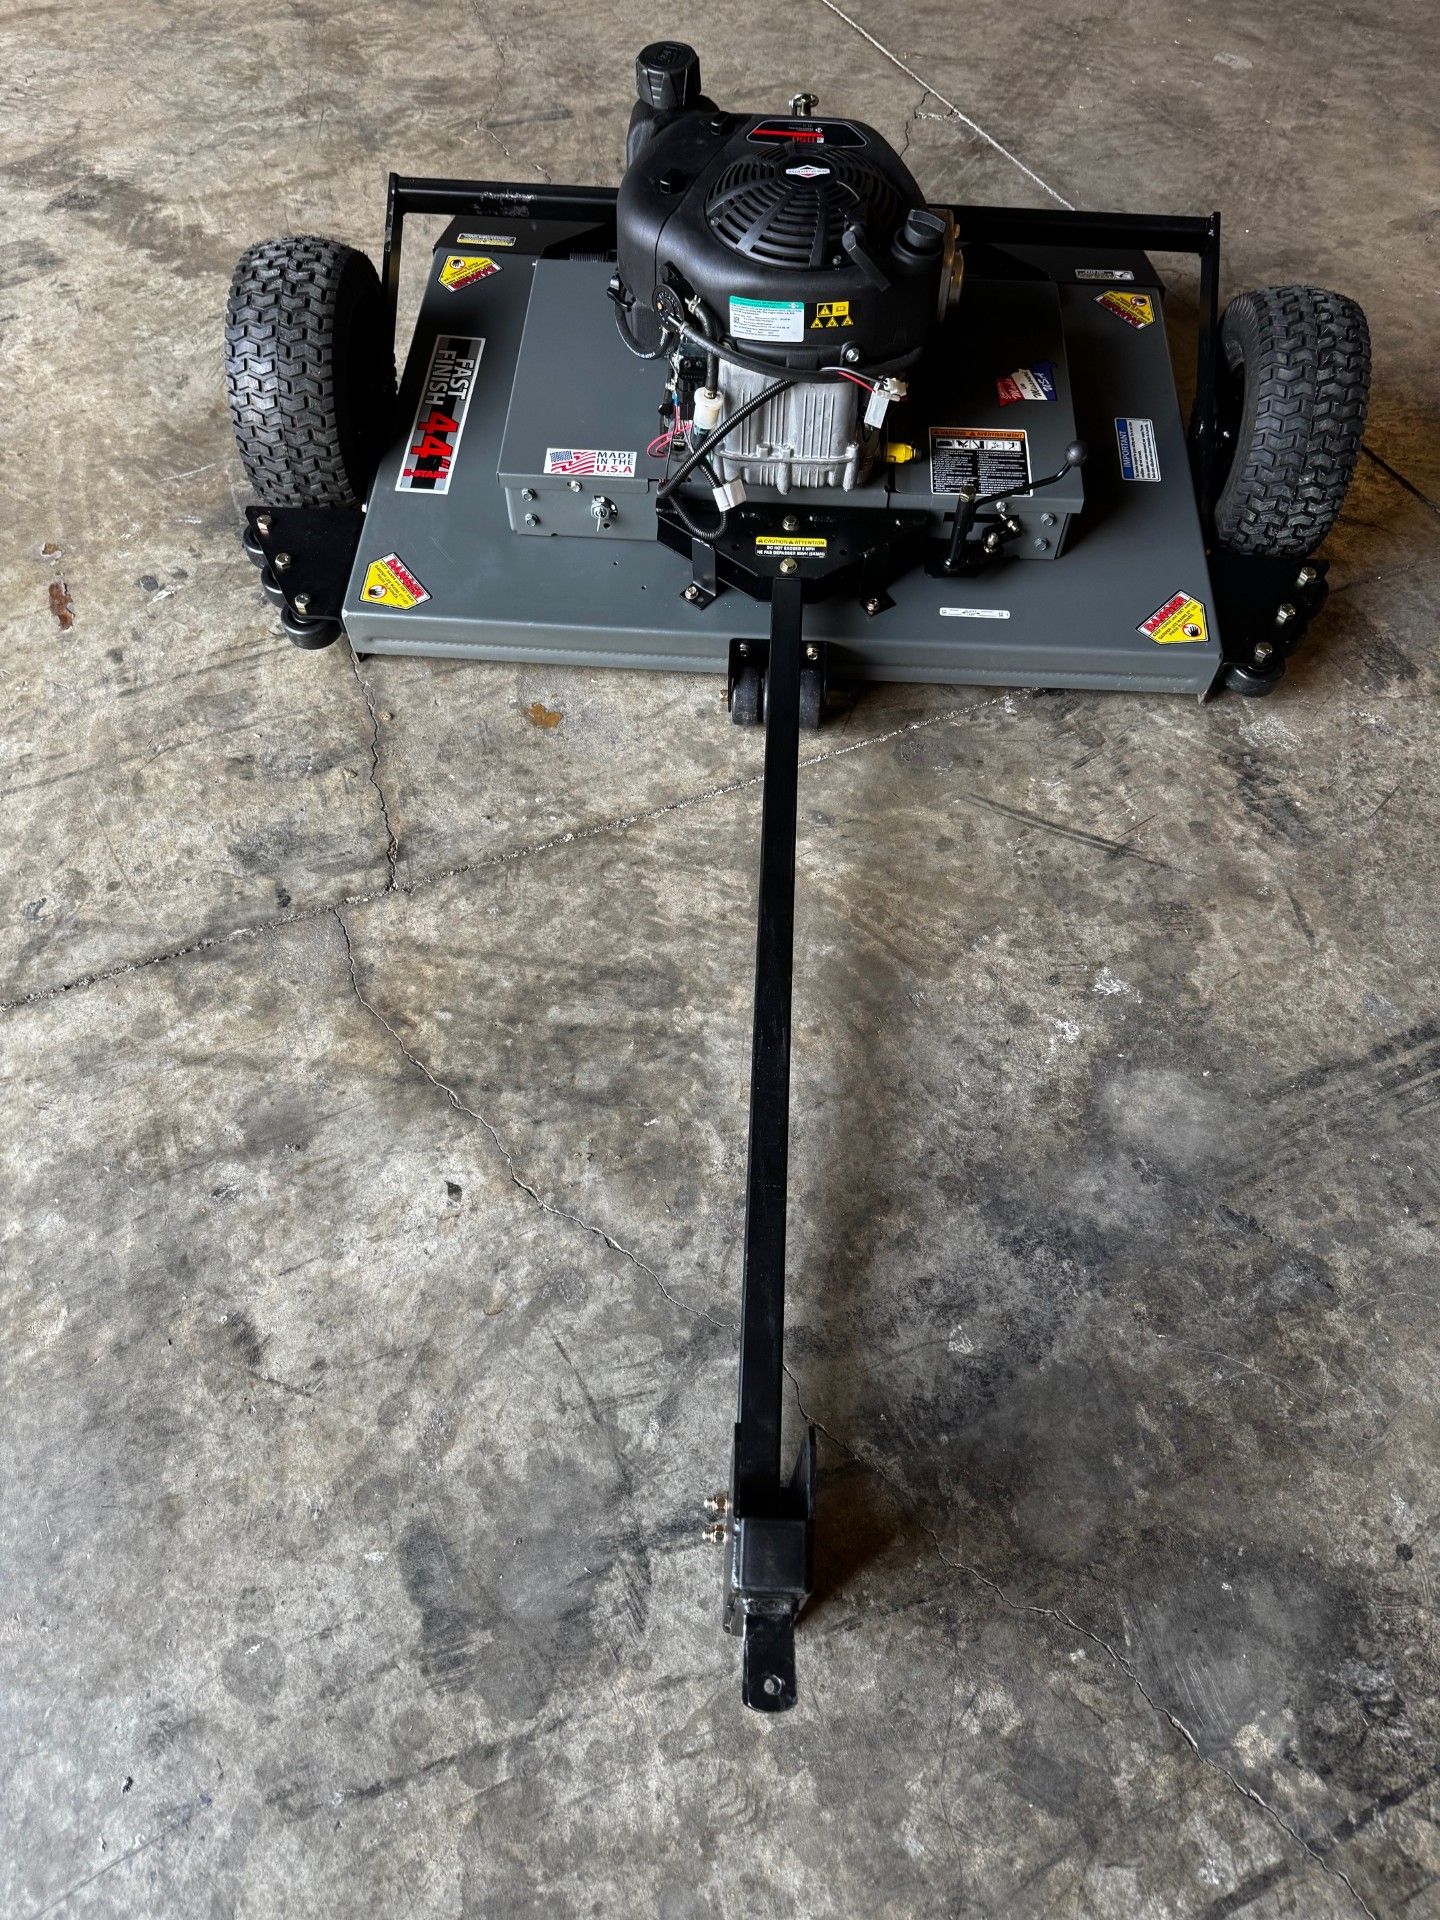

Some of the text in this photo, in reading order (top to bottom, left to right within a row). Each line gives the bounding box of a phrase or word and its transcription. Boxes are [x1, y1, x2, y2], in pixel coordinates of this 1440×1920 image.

[425, 350, 457, 406] FINISH
[448, 358, 475, 400] FAST
[597, 452, 634, 460] MADE
[1120, 431, 1131, 468] IMPORTANT
[386, 557, 424, 599] DANGER
[1143, 594, 1187, 632] DANGER
